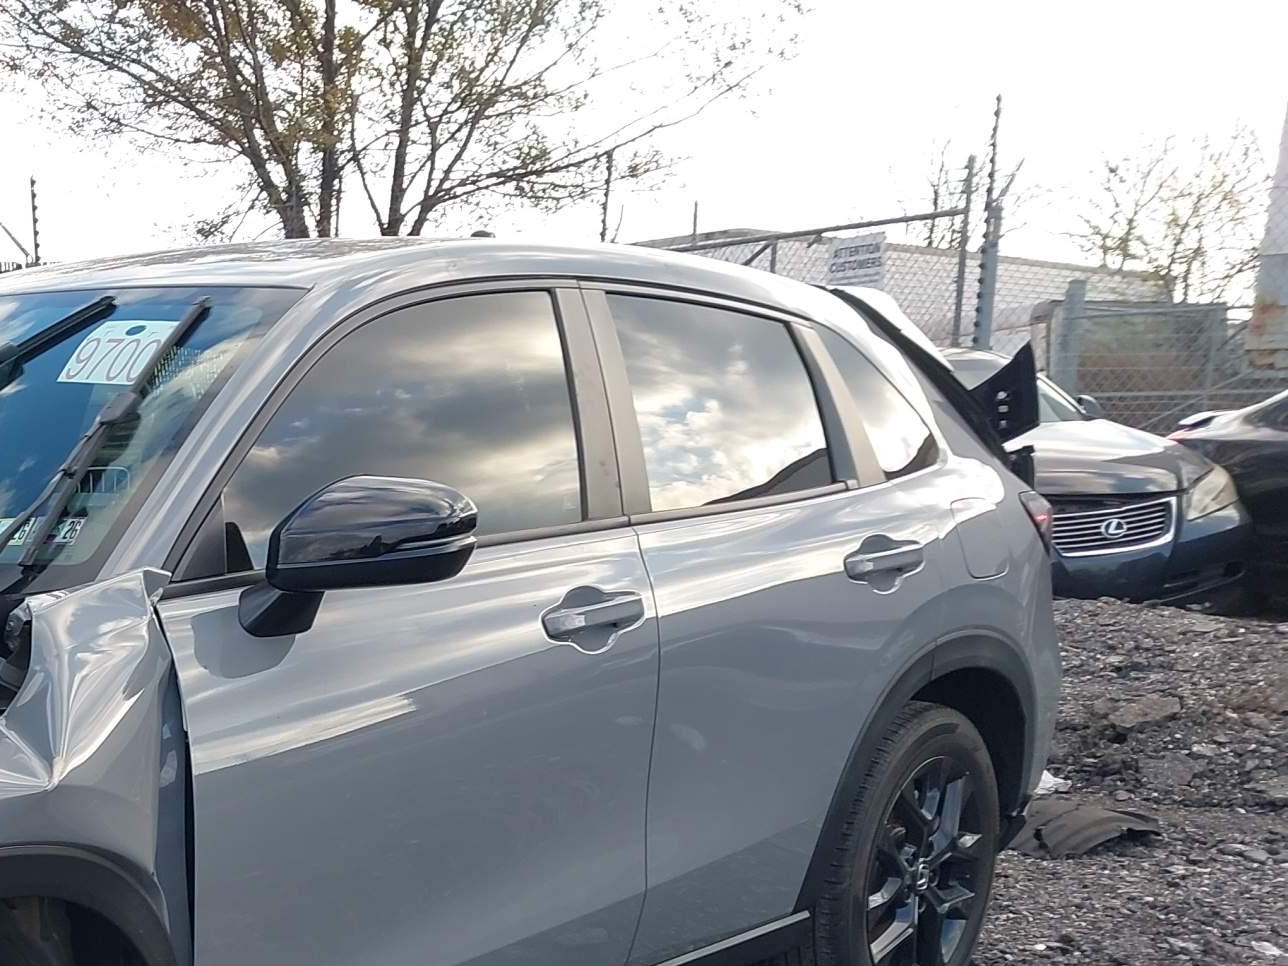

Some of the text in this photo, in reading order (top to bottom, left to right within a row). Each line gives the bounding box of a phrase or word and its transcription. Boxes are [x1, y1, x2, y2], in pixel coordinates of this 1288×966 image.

[833, 243, 881, 258] ATTENTION
[829, 256, 882, 274] CUSTOMERS
[65, 337, 162, 382] 9700
[62, 520, 82, 540] 26
